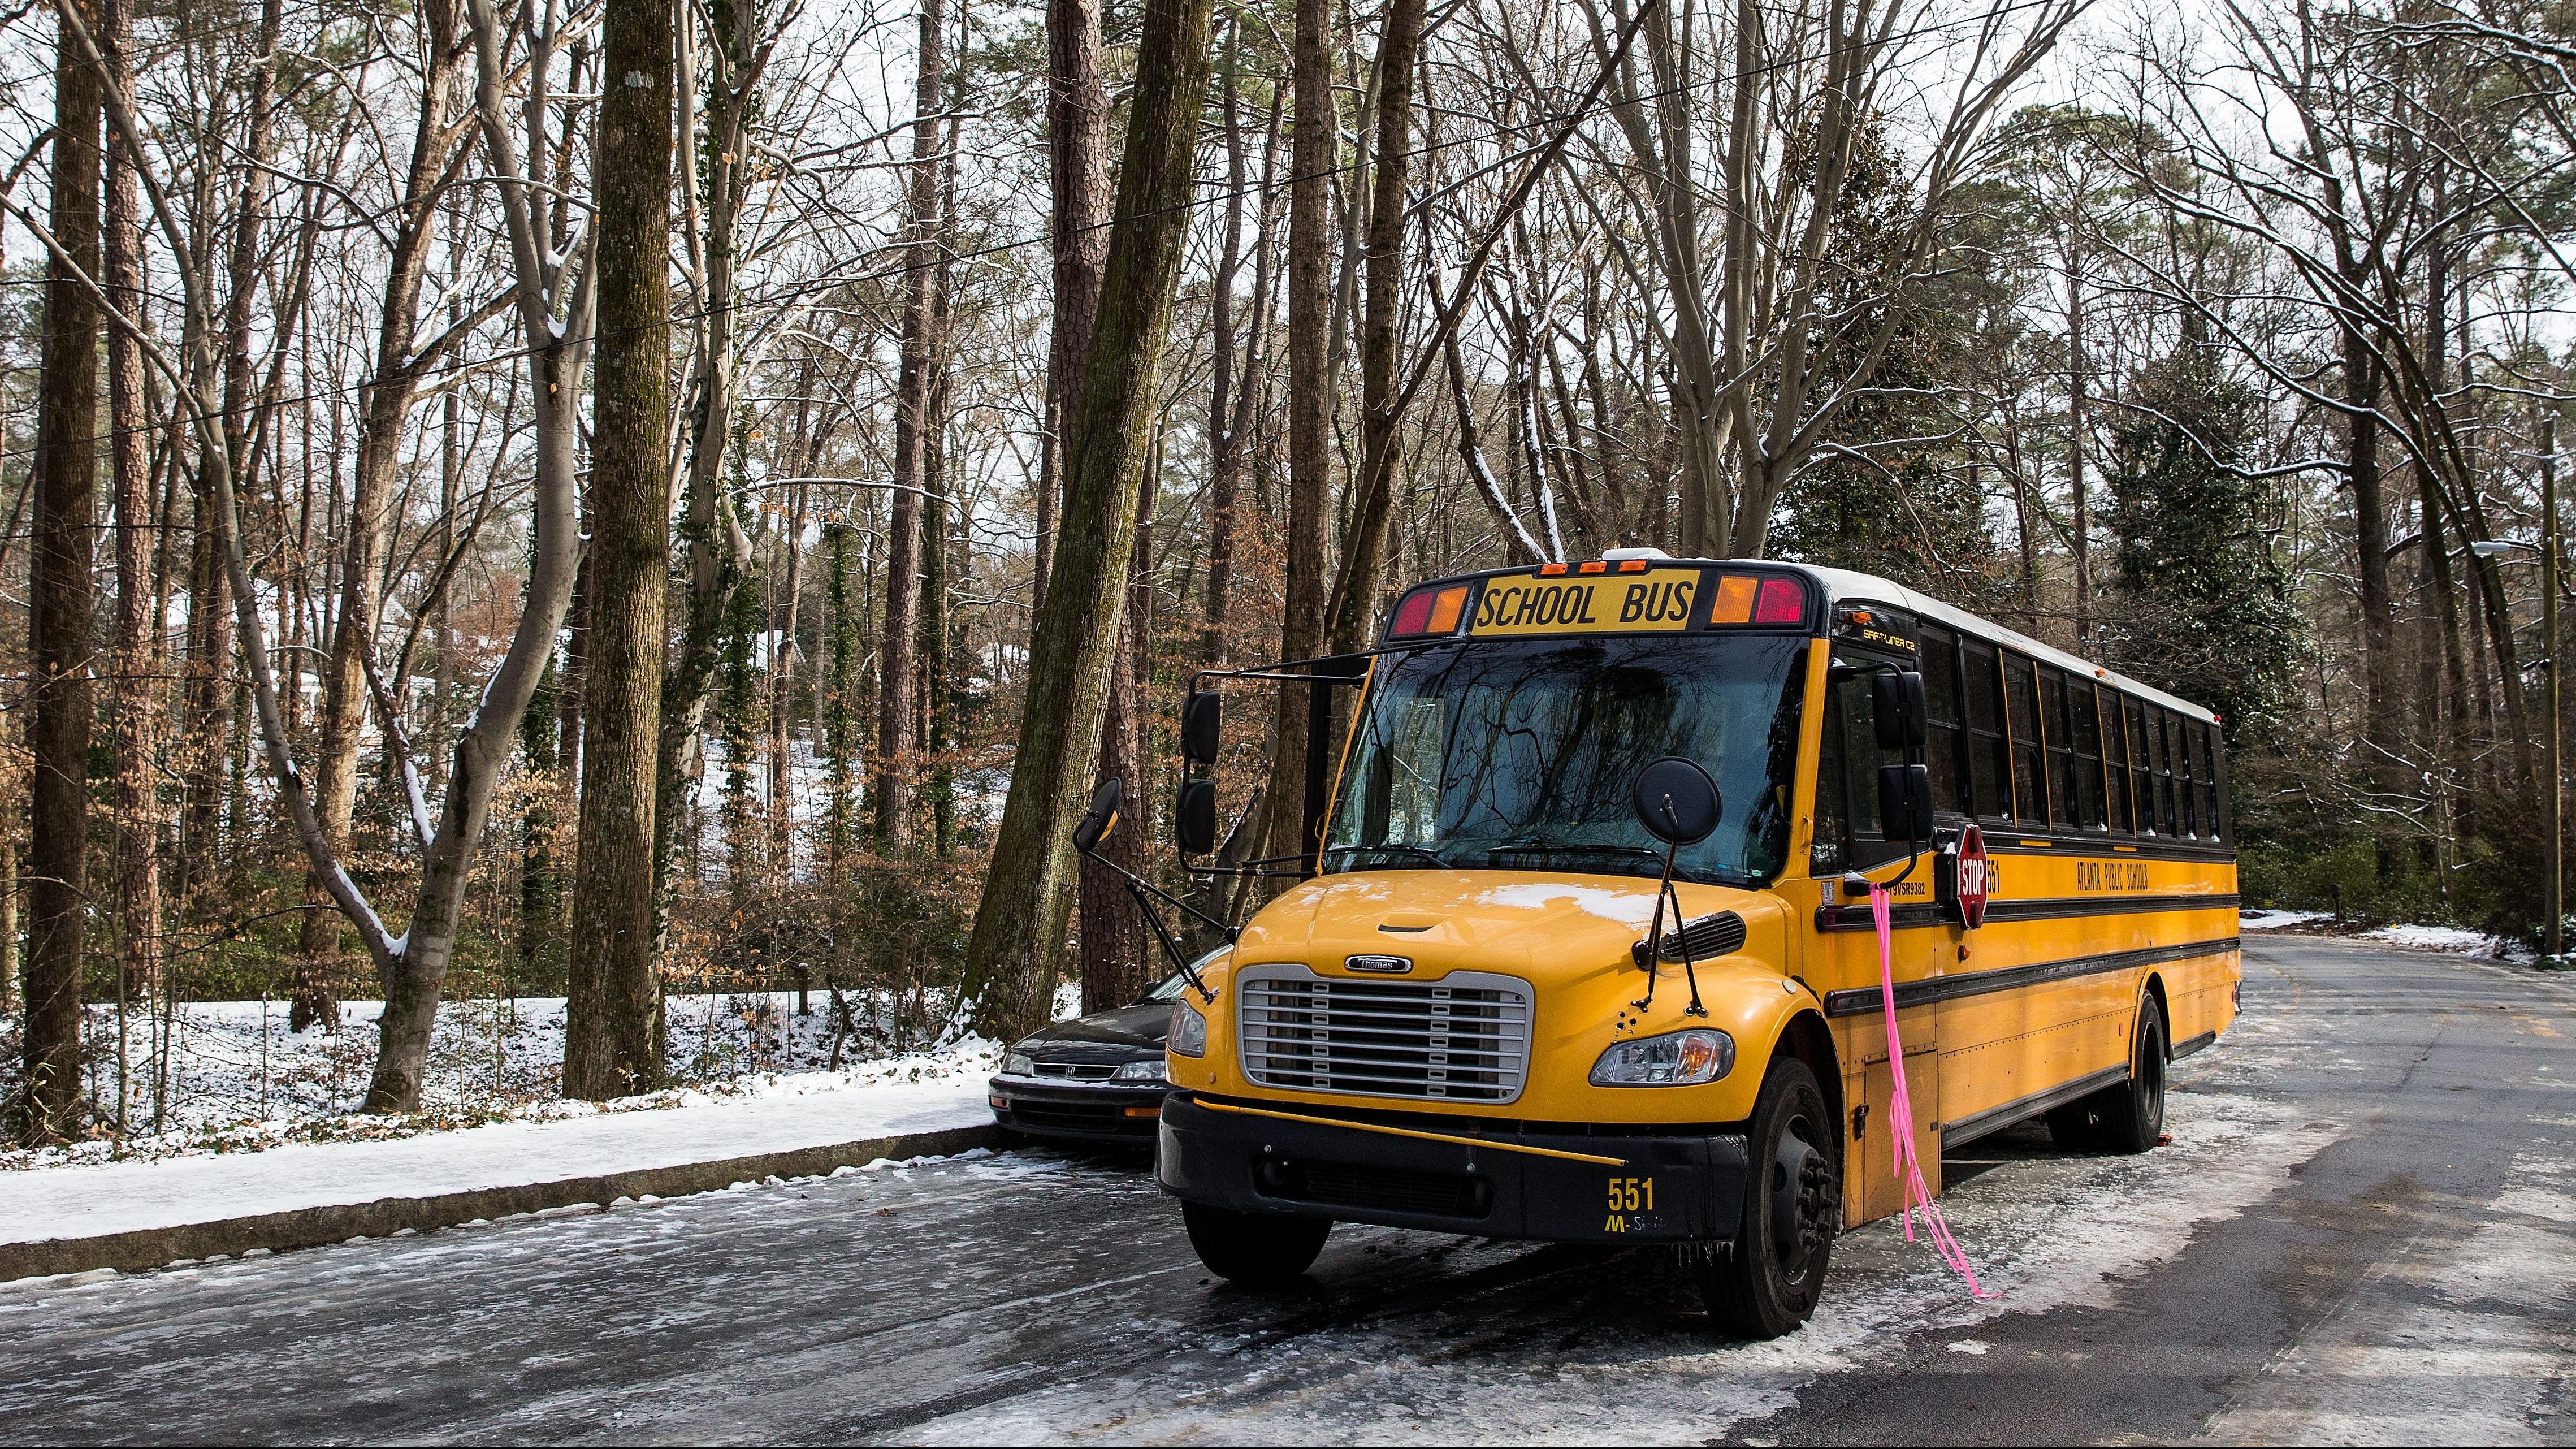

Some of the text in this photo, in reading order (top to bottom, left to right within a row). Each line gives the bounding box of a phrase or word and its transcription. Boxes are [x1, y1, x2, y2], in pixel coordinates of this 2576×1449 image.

[1477, 581, 1694, 627] SCHOOL BUS
[1906, 639, 1915, 651] C2
[1962, 859, 1984, 896] STOP
[1988, 860, 1999, 894] 551
[2077, 862, 2148, 891] ATLANTA PUBLIC SCHOOLS
[1358, 958, 1398, 969] Thomas
[1609, 1177, 1653, 1211] 551
